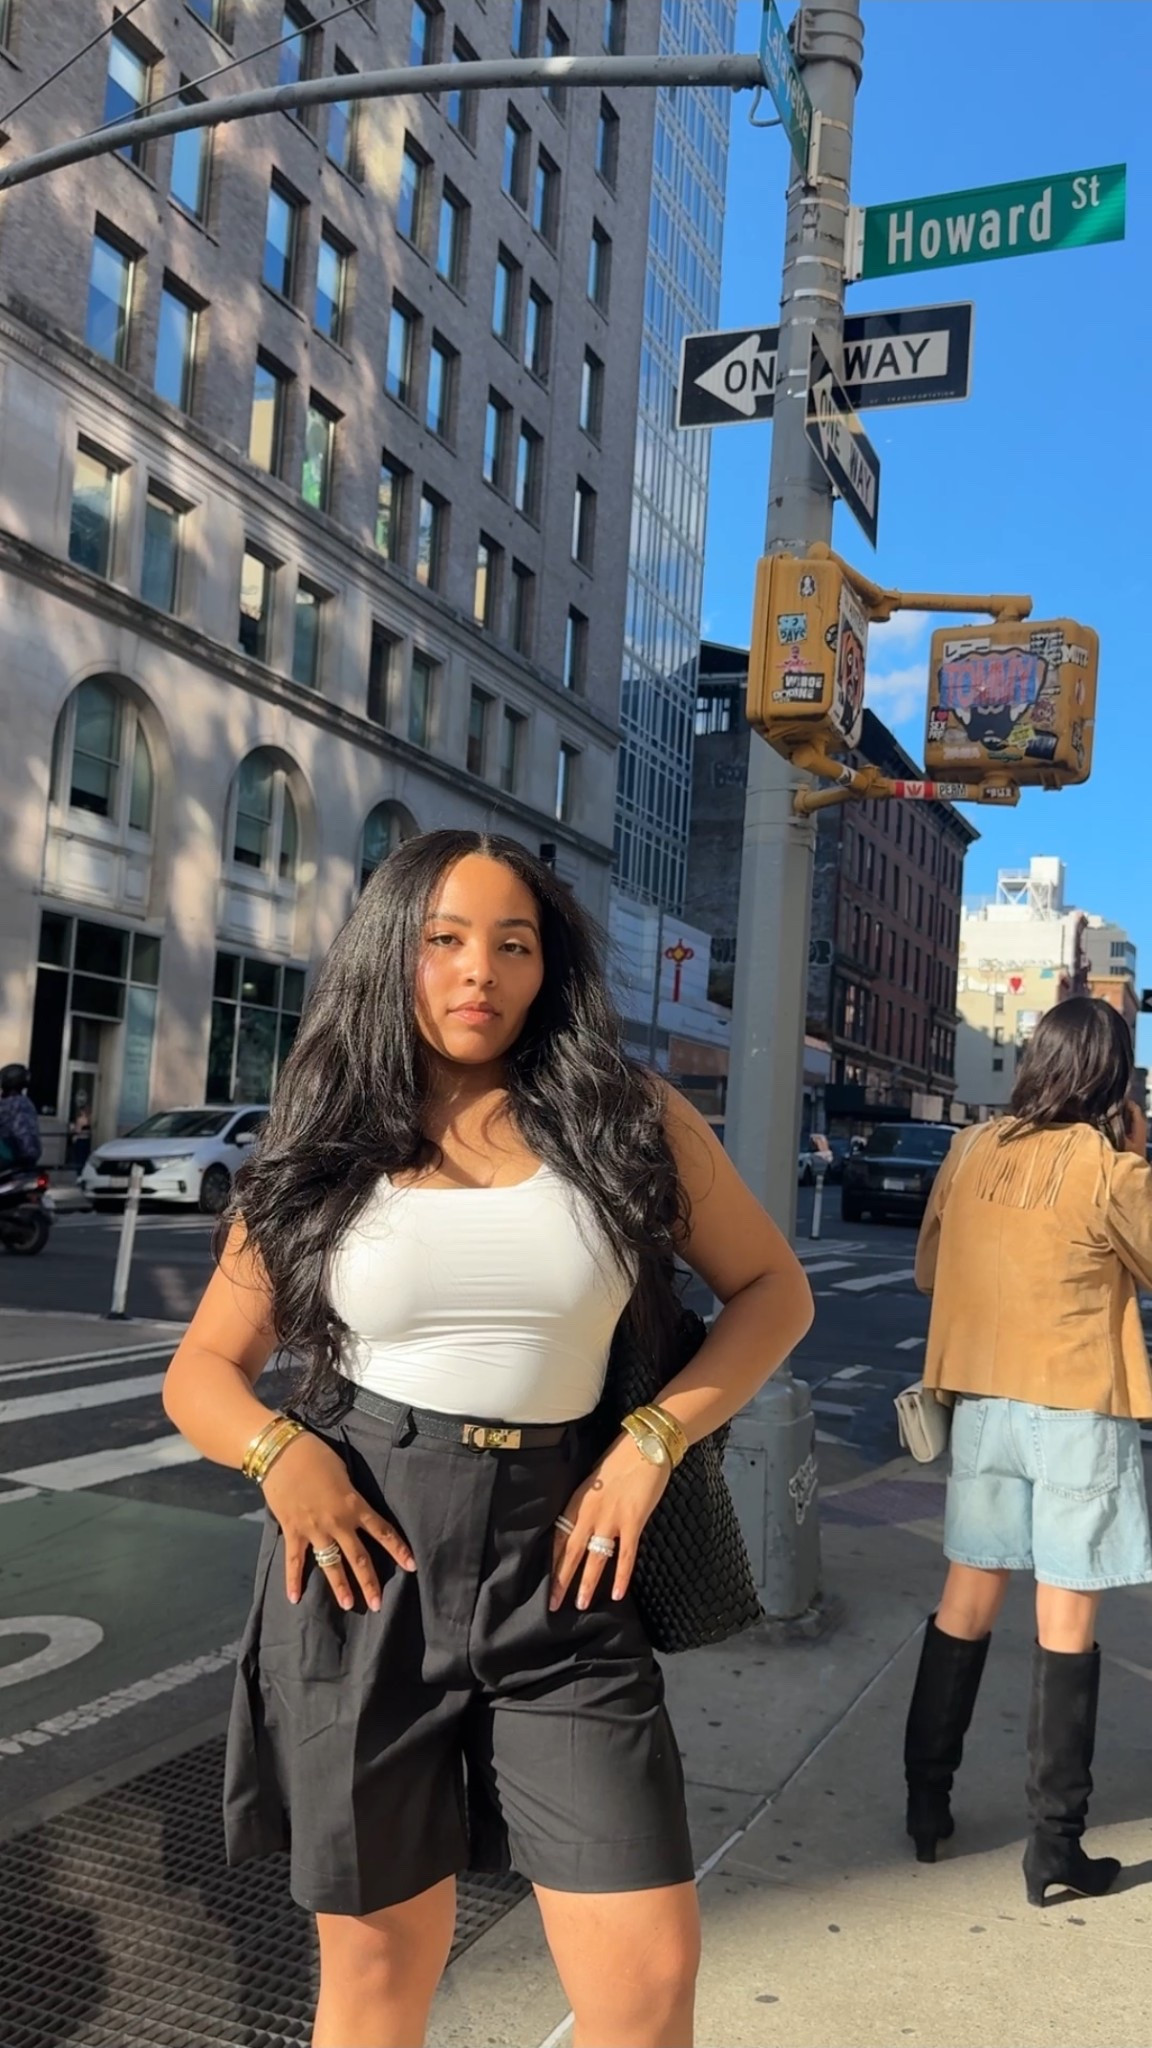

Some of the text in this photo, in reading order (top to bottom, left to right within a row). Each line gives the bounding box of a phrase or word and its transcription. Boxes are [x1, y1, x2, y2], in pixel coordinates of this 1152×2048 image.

[887, 175, 1100, 264] Howard St
[724, 337, 931, 394] ON WAY
[819, 388, 871, 504] ONE WAY
